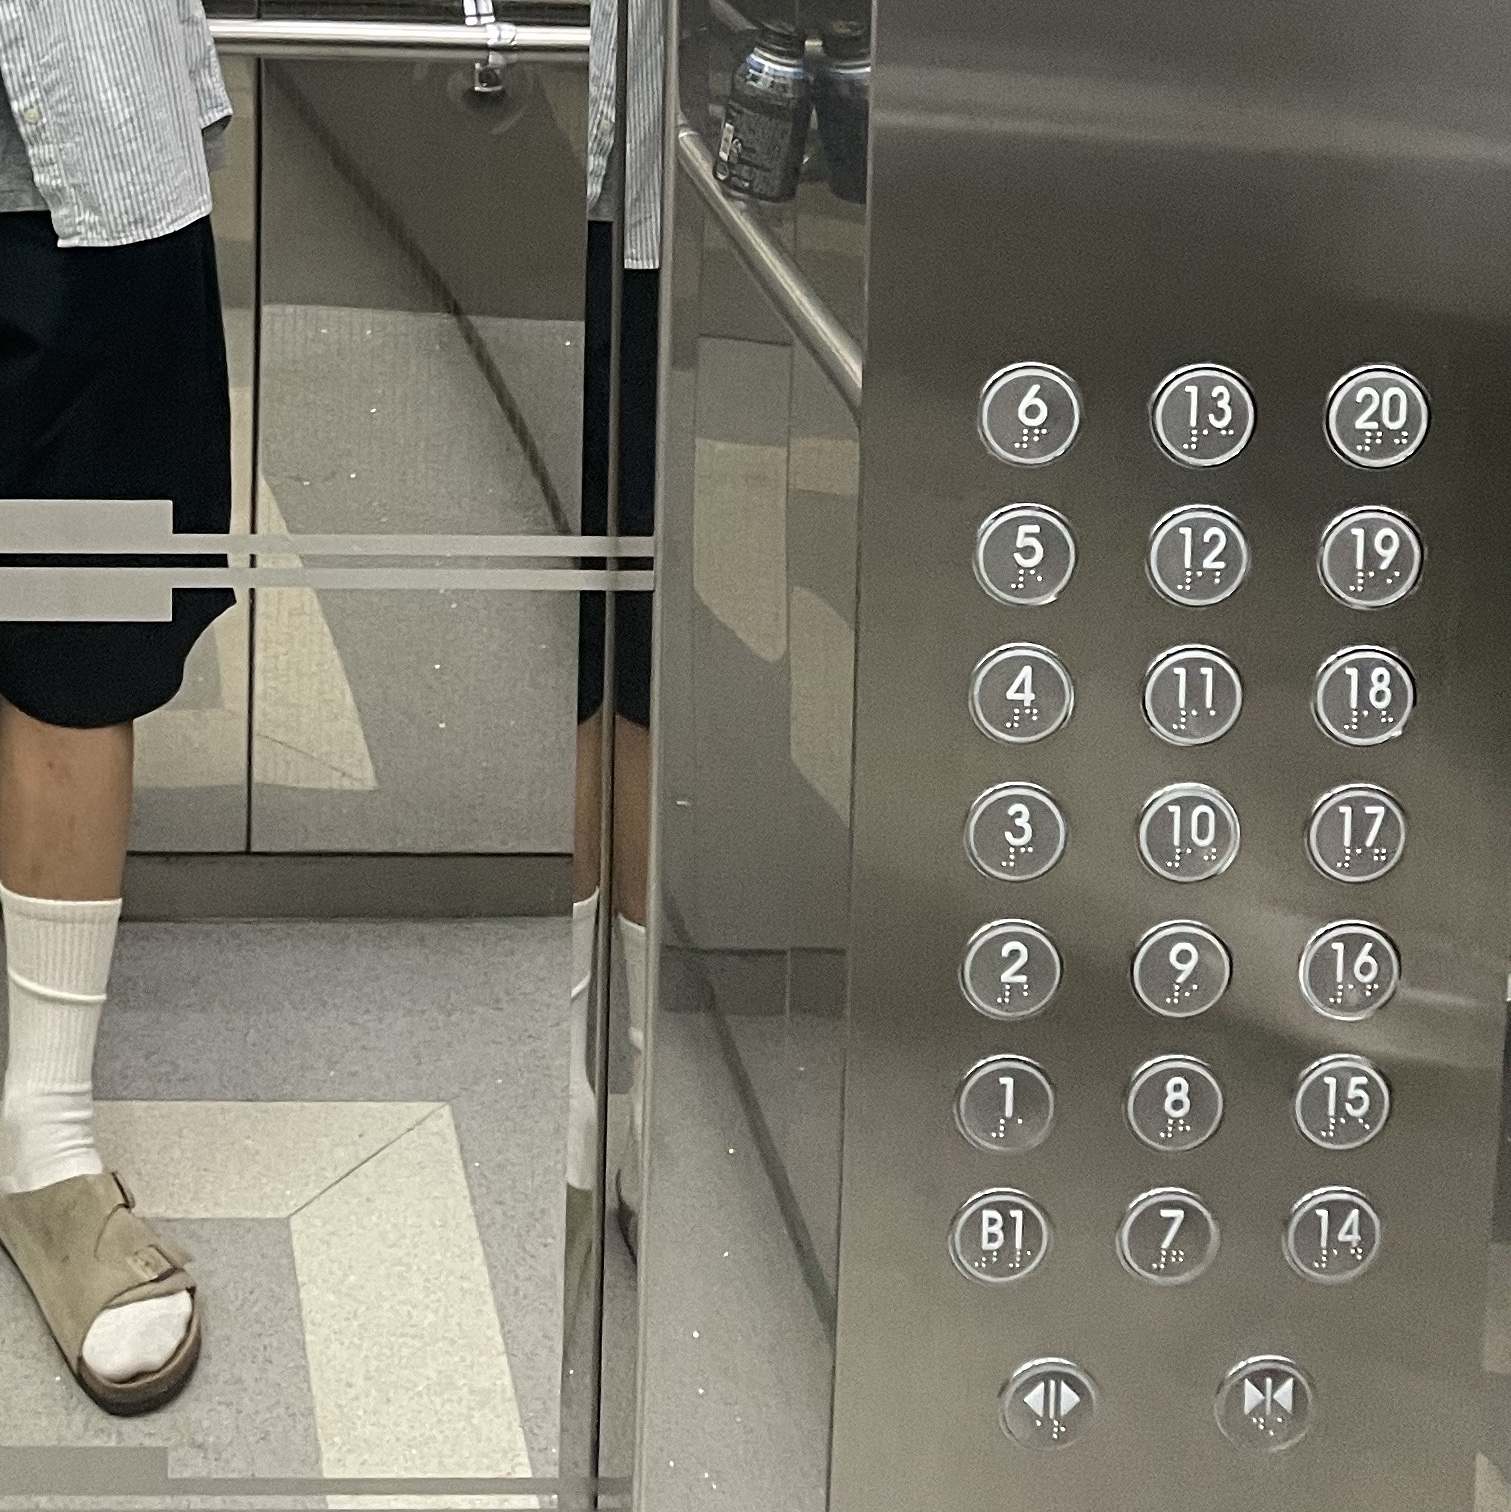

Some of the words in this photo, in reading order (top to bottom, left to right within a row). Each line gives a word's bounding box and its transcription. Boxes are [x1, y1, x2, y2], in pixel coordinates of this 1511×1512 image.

[1017, 385, 1048, 427] 6
[1184, 385, 1233, 429] 13
[1354, 386, 1409, 430] 20
[1013, 525, 1044, 567] 5
[1178, 527, 1227, 569] 12
[1350, 528, 1400, 570] 19
[1006, 665, 1036, 707] 4
[1173, 667, 1215, 709] 11
[1344, 667, 1392, 709] 18
[1004, 804, 1033, 847] 3
[1167, 805, 1216, 848] 10
[1338, 806, 1386, 848] 17
[1000, 941, 1028, 983] 2
[1169, 941, 1199, 984] 9
[1331, 943, 1379, 984] 16
[999, 1076, 1015, 1118] 1
[1164, 1077, 1191, 1119] 8
[1322, 1076, 1371, 1118] 15
[981, 1209, 1026, 1251] B1
[1160, 1209, 1185, 1251] 7
[1314, 1208, 1362, 1250] 14
